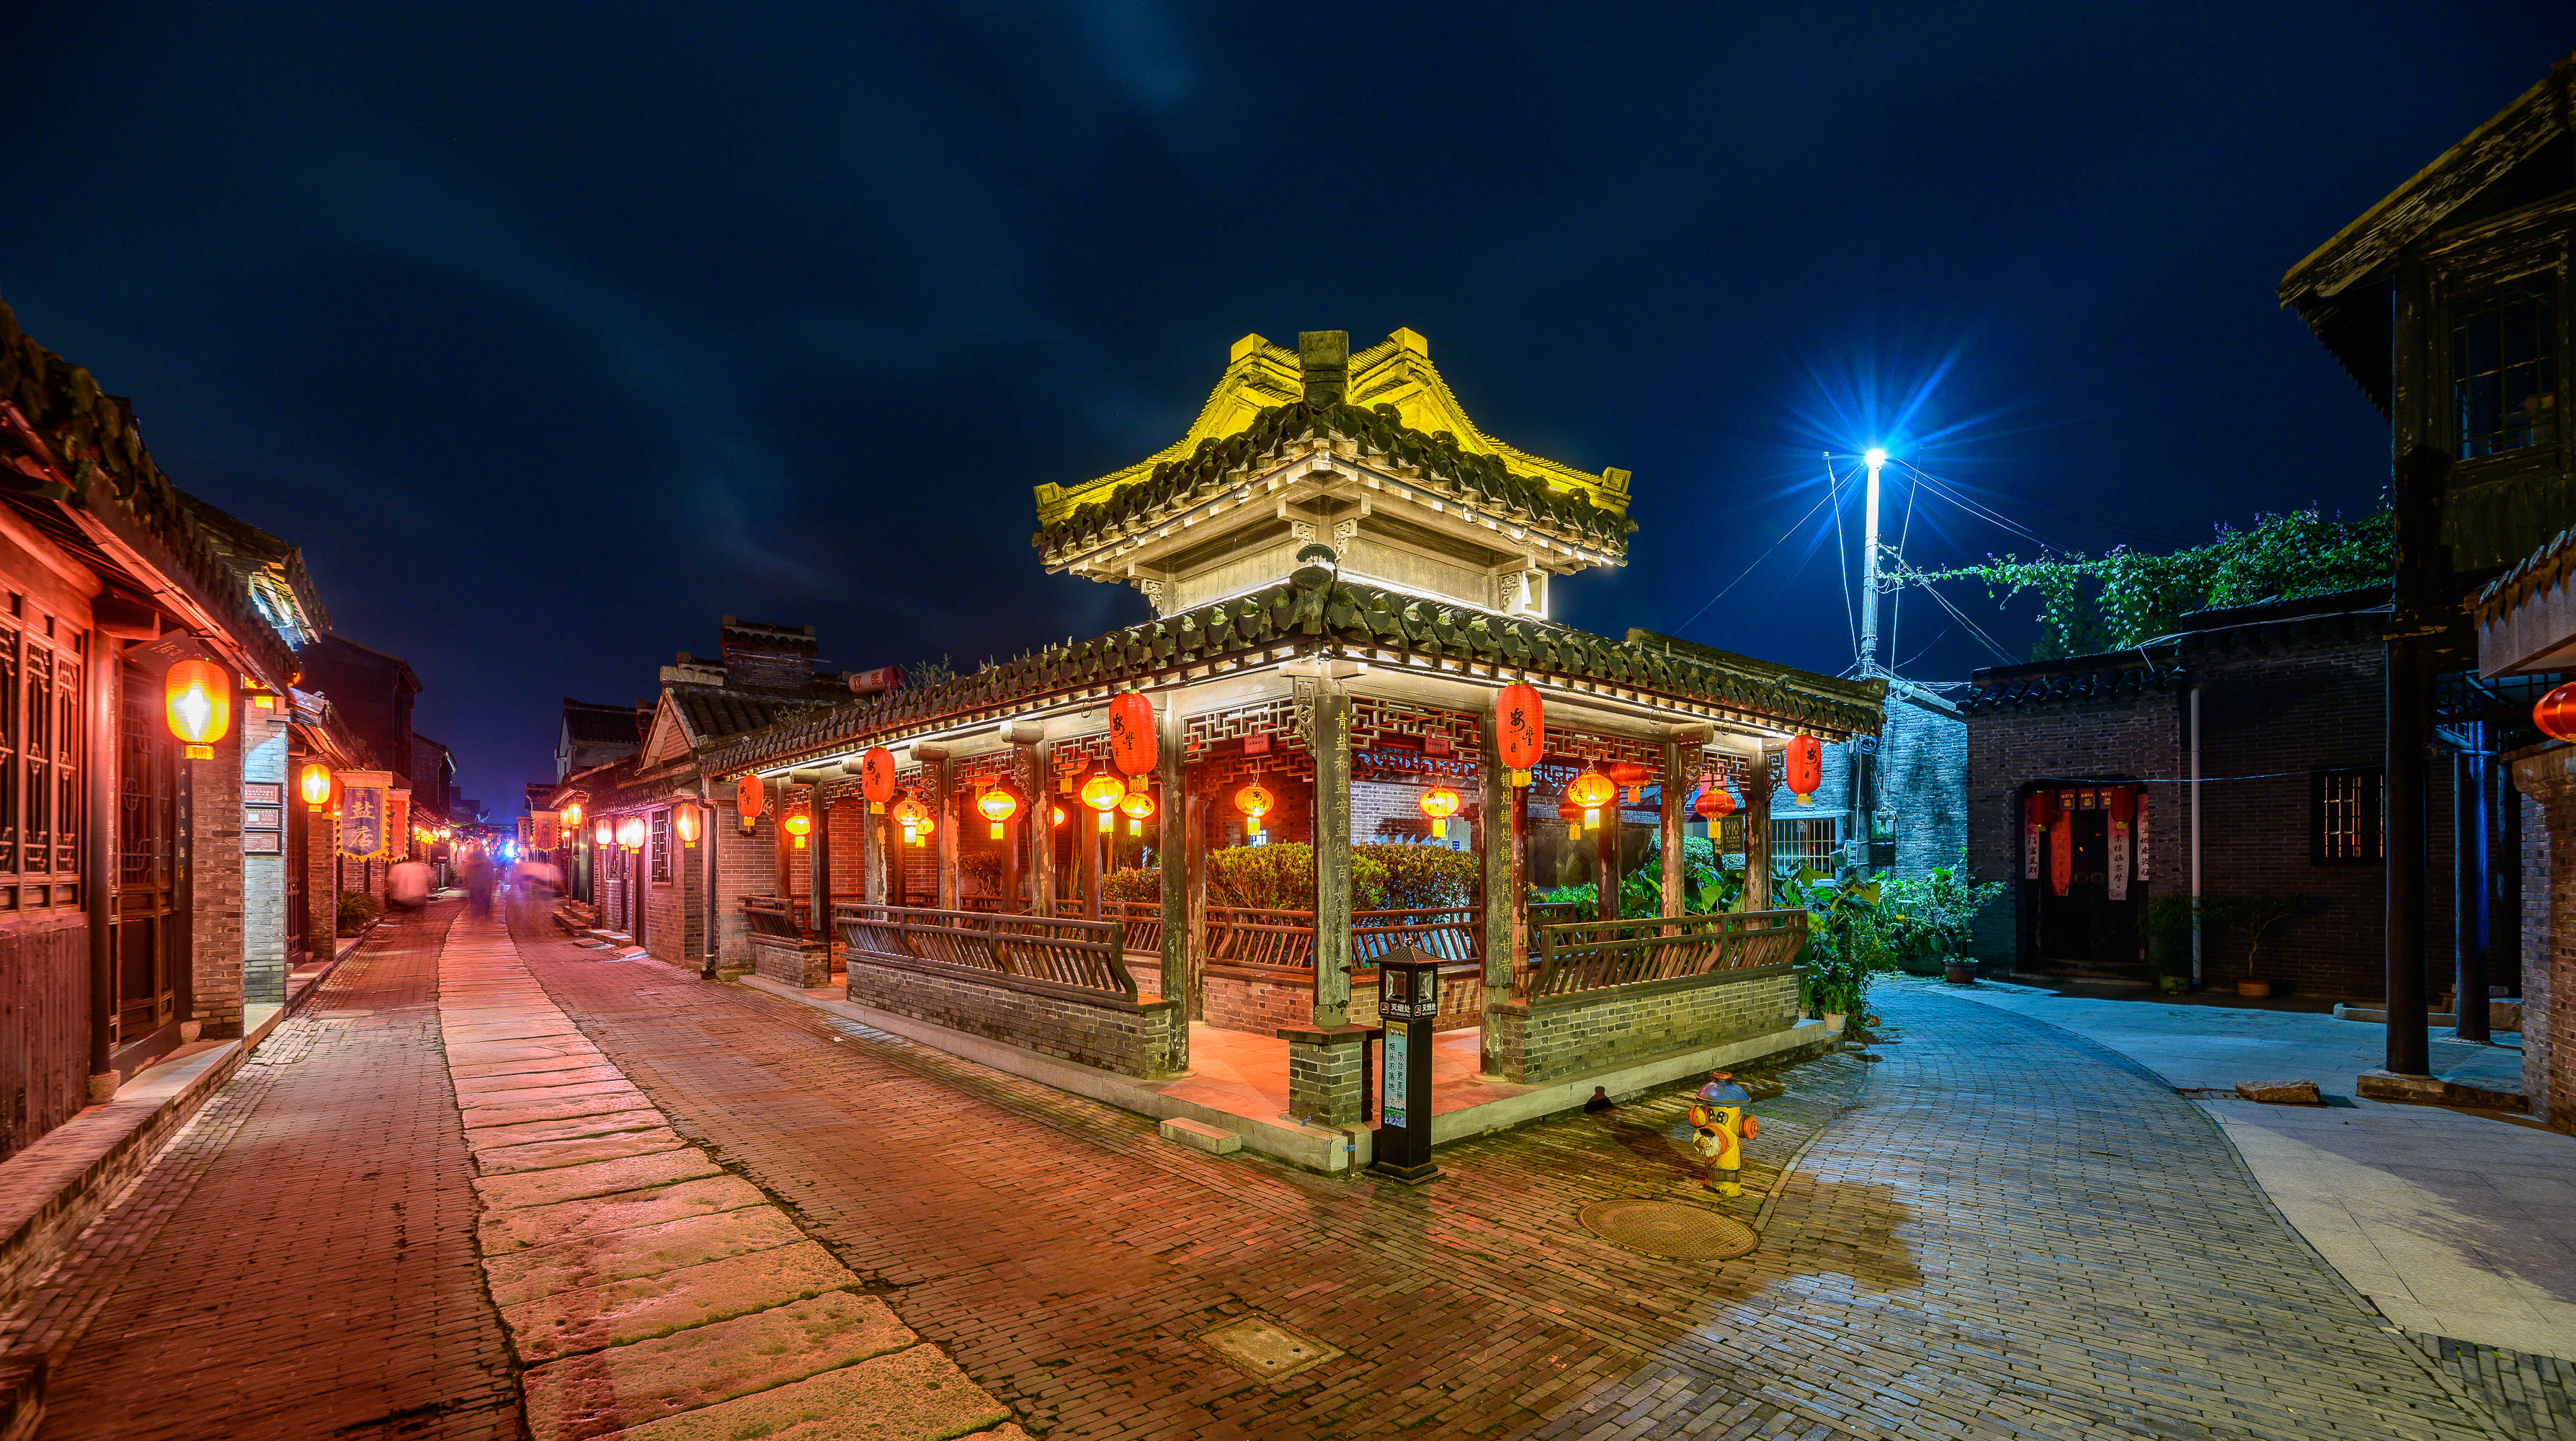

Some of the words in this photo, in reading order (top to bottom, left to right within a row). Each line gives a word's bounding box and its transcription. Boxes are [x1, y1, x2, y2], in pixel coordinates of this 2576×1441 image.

[349, 800, 376, 848] 盐店
[1391, 1003, 1411, 1013] 灭烟处
[1422, 1002, 1437, 1012] 灭烟处
